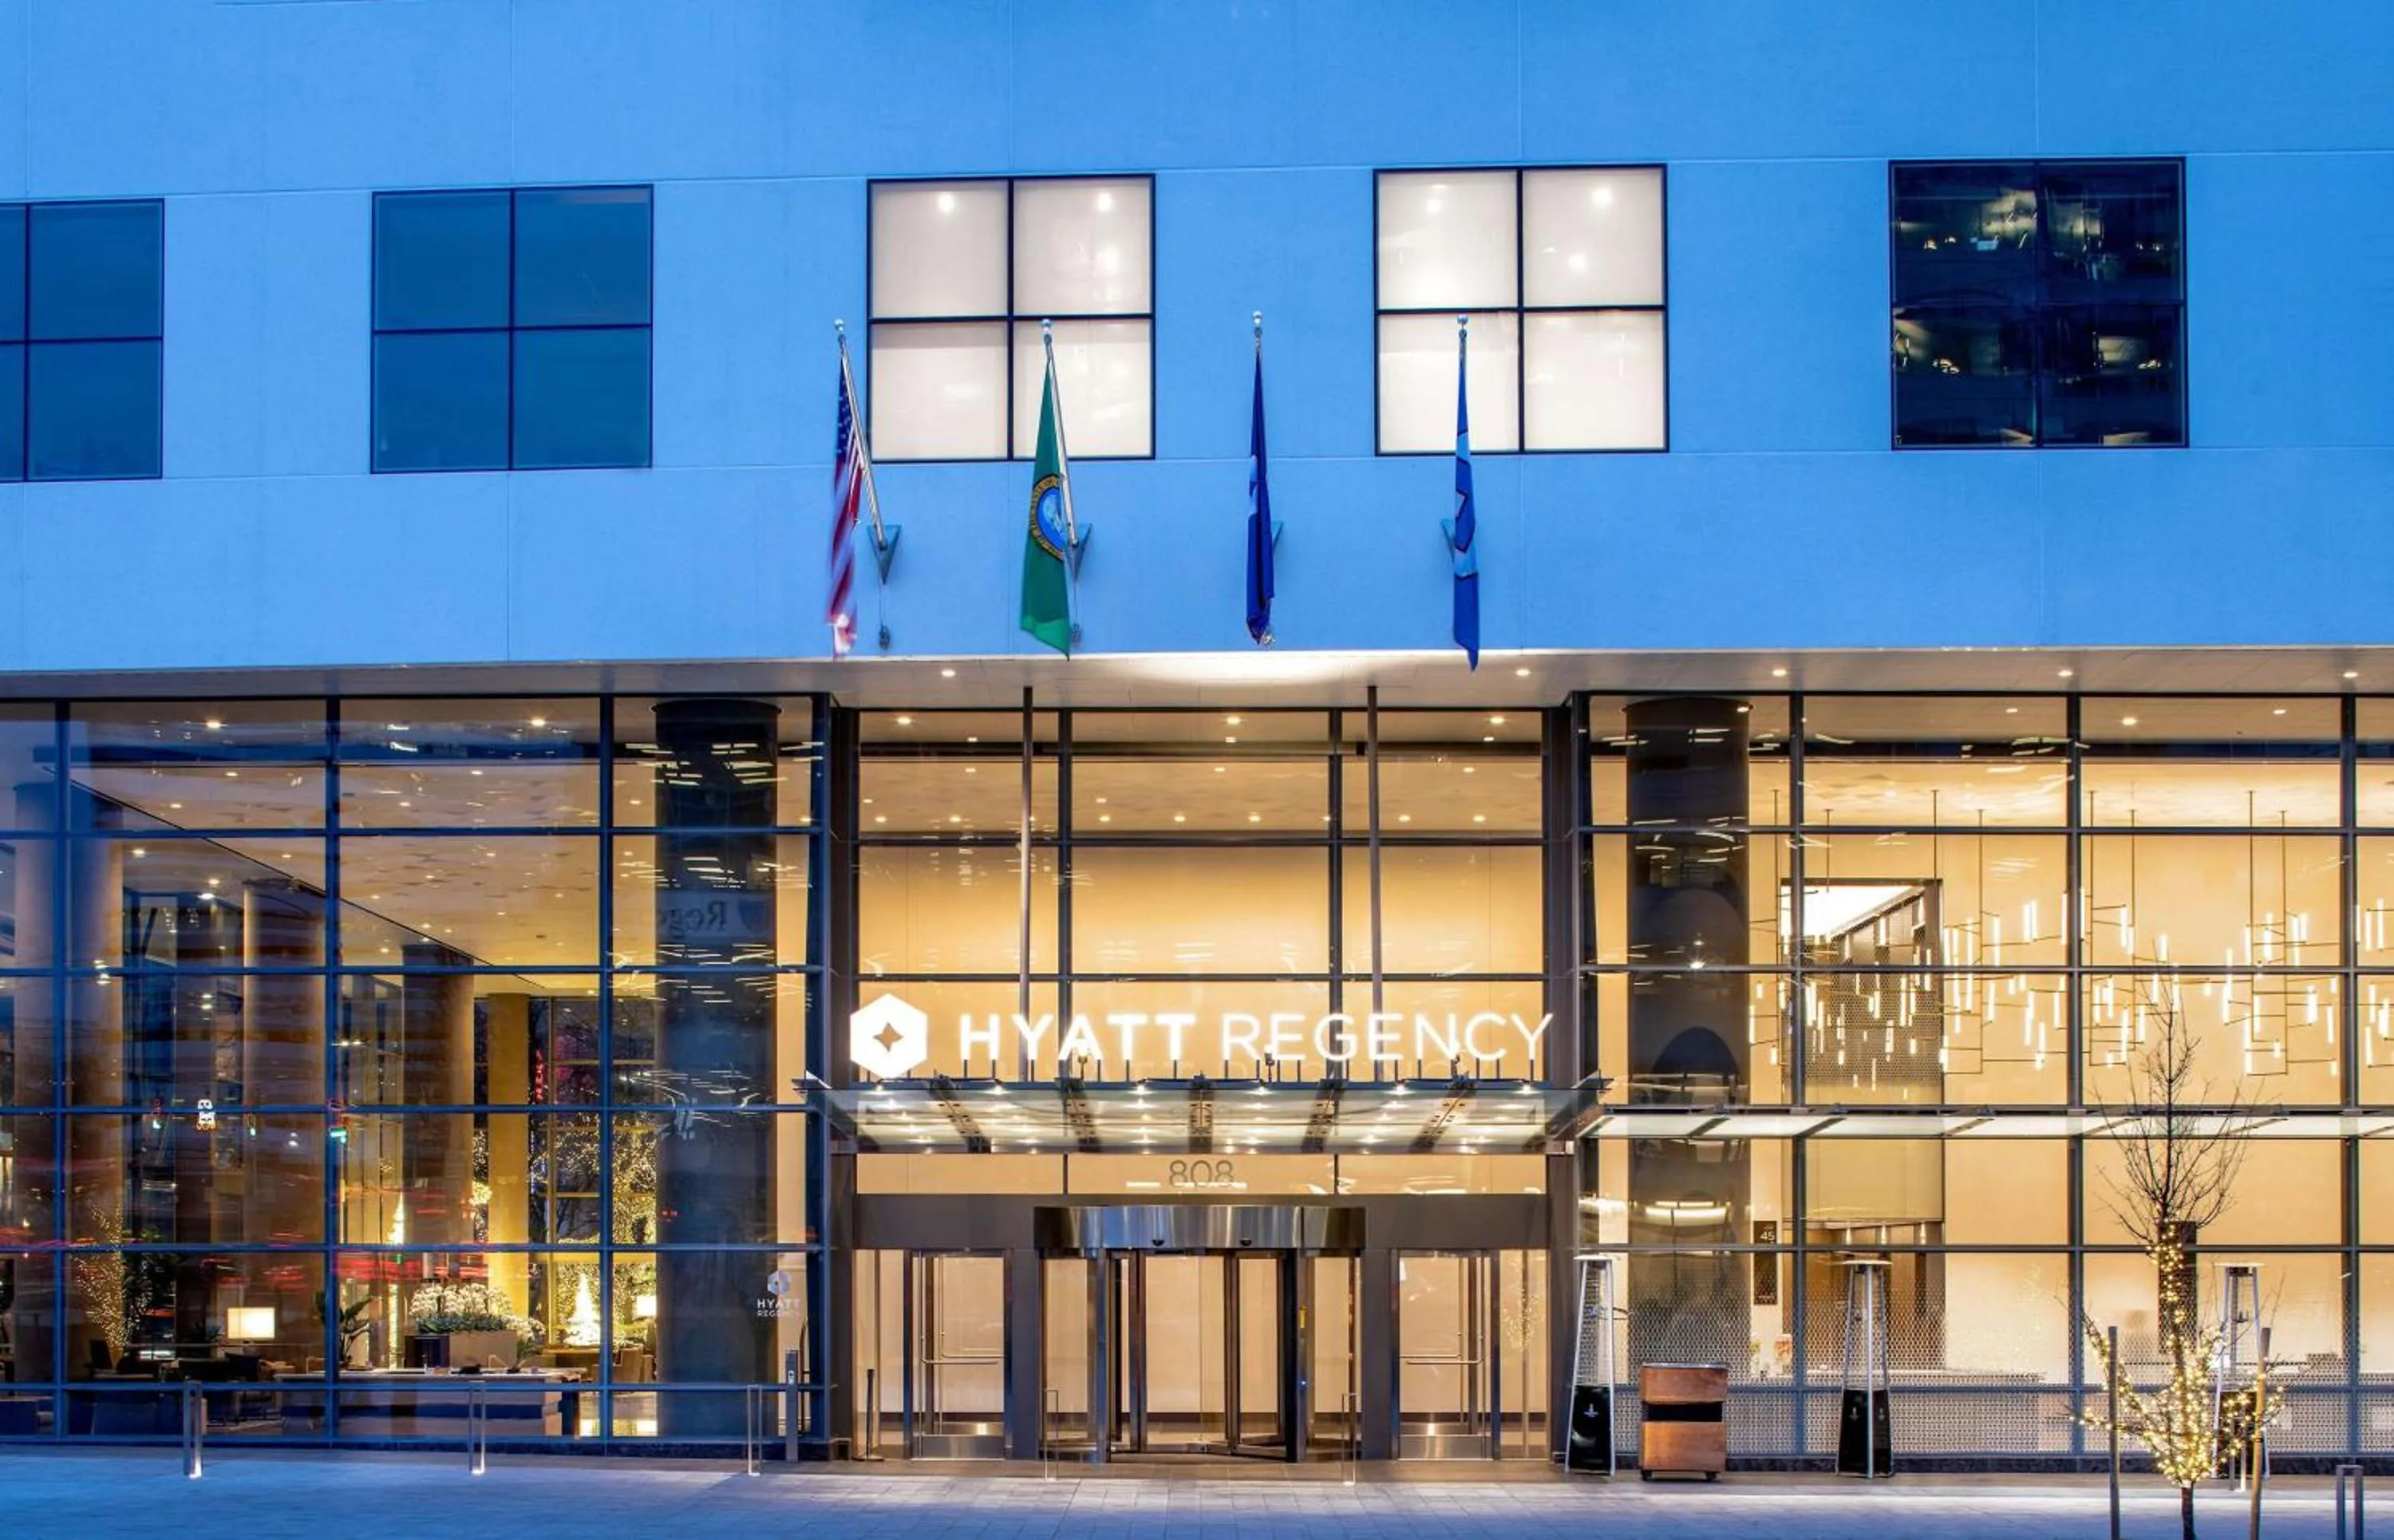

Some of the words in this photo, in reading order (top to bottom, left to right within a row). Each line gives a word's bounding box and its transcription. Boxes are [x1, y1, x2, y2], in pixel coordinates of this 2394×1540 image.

[960, 1013, 1195, 1060] HYATT
[1222, 1013, 1554, 1060] REGENCY
[1169, 1160, 1235, 1187] 808
[757, 1299, 800, 1309] HYATT
